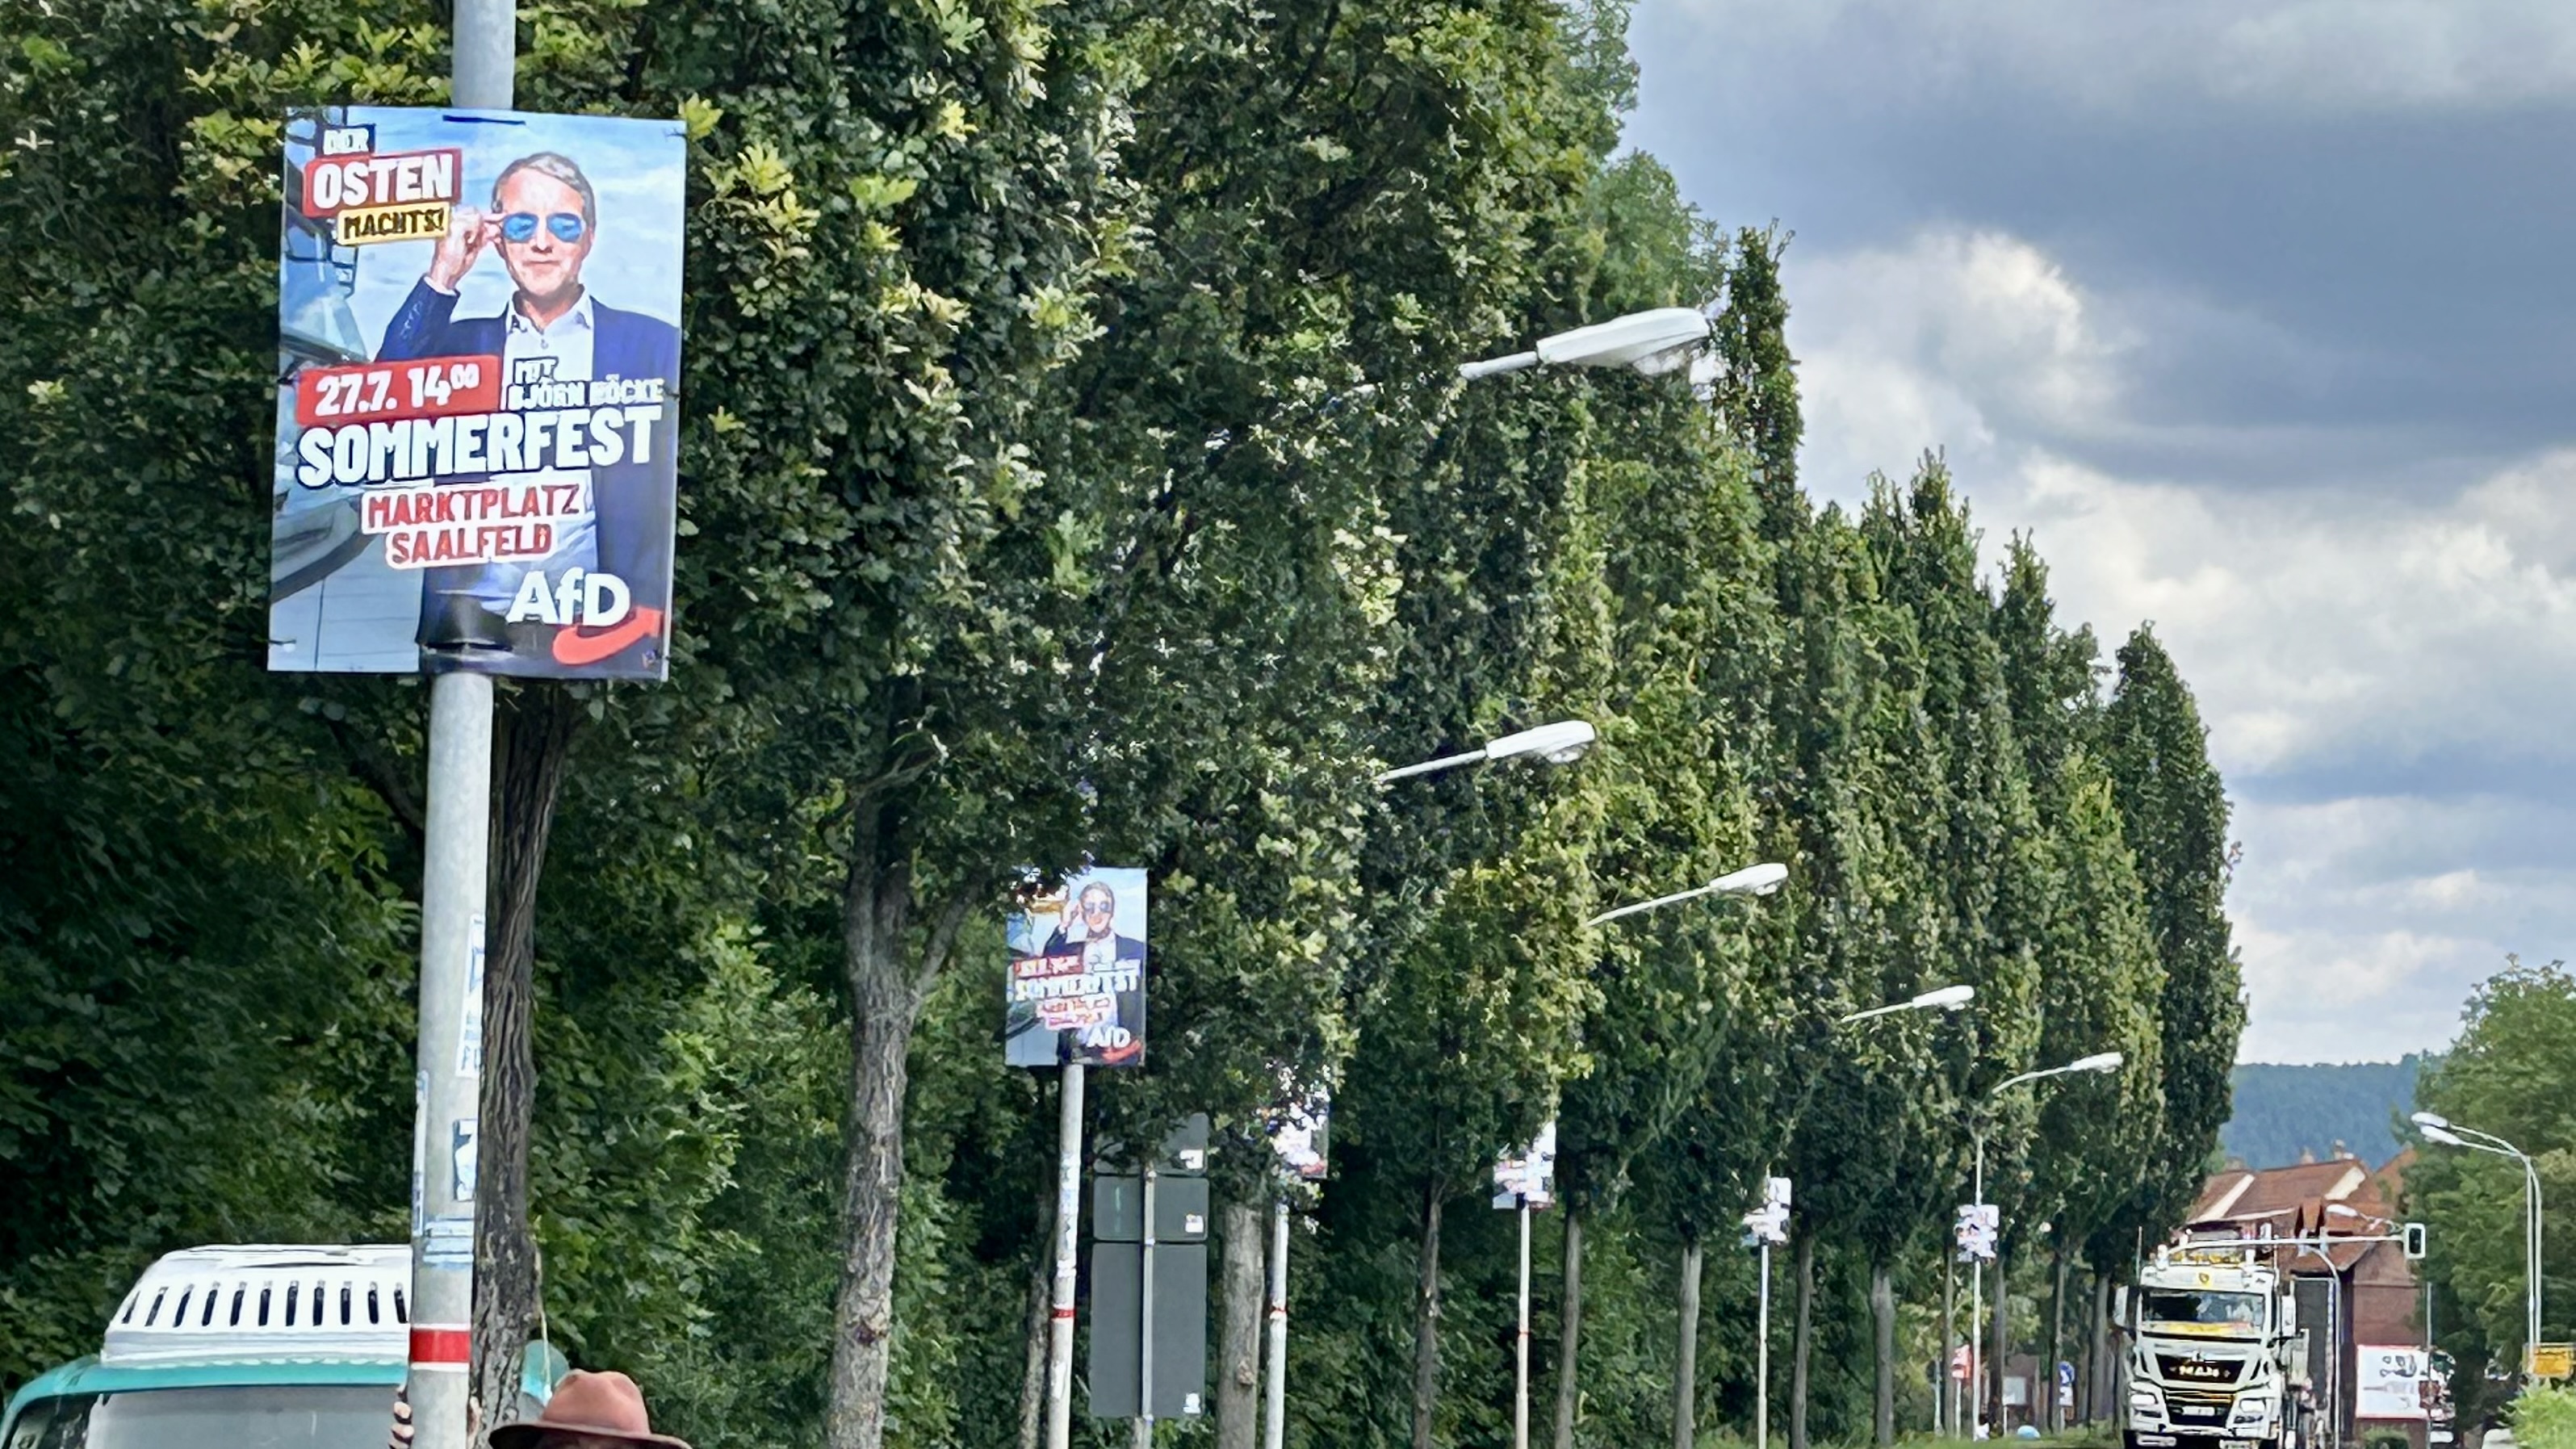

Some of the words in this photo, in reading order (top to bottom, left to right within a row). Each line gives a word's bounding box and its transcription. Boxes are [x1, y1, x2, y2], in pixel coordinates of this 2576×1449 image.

[324, 128, 370, 155] DER
[313, 153, 453, 208] OSTEN
[514, 358, 557, 384] MIT
[315, 370, 397, 416] 27.7.
[508, 376, 585, 410] BJÖRN
[589, 374, 664, 406] HÖCKE
[297, 405, 662, 488] SOMMERFEST
[368, 484, 580, 527] MARKTPLATZ
[391, 523, 552, 563] SAALFELD
[505, 567, 630, 626] AfD
[1087, 1026, 1131, 1049] AfD
[2180, 1365, 2219, 1377] MAN
